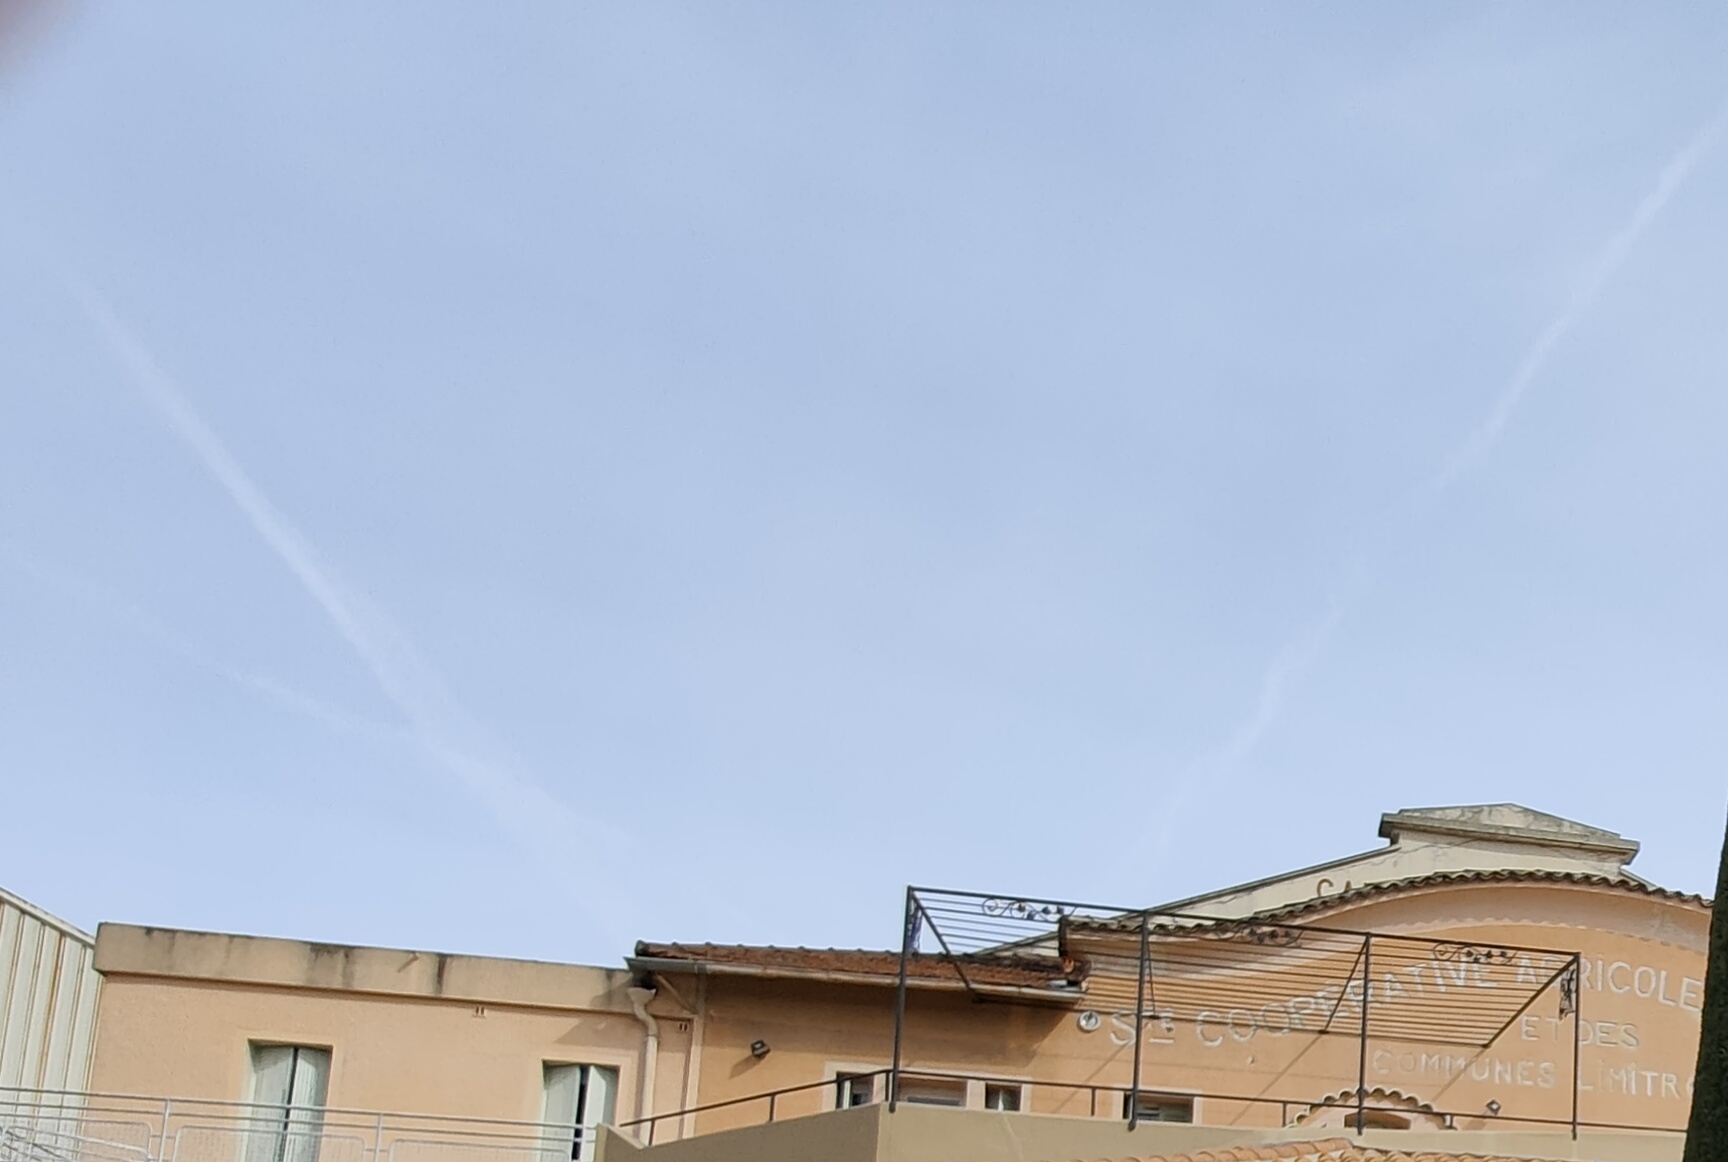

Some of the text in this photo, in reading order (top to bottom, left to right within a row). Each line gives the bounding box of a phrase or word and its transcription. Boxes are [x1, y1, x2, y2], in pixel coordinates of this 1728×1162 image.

[1521, 1015, 1640, 1048] ET DES
[1372, 1050, 1557, 1088] COMMUNES
